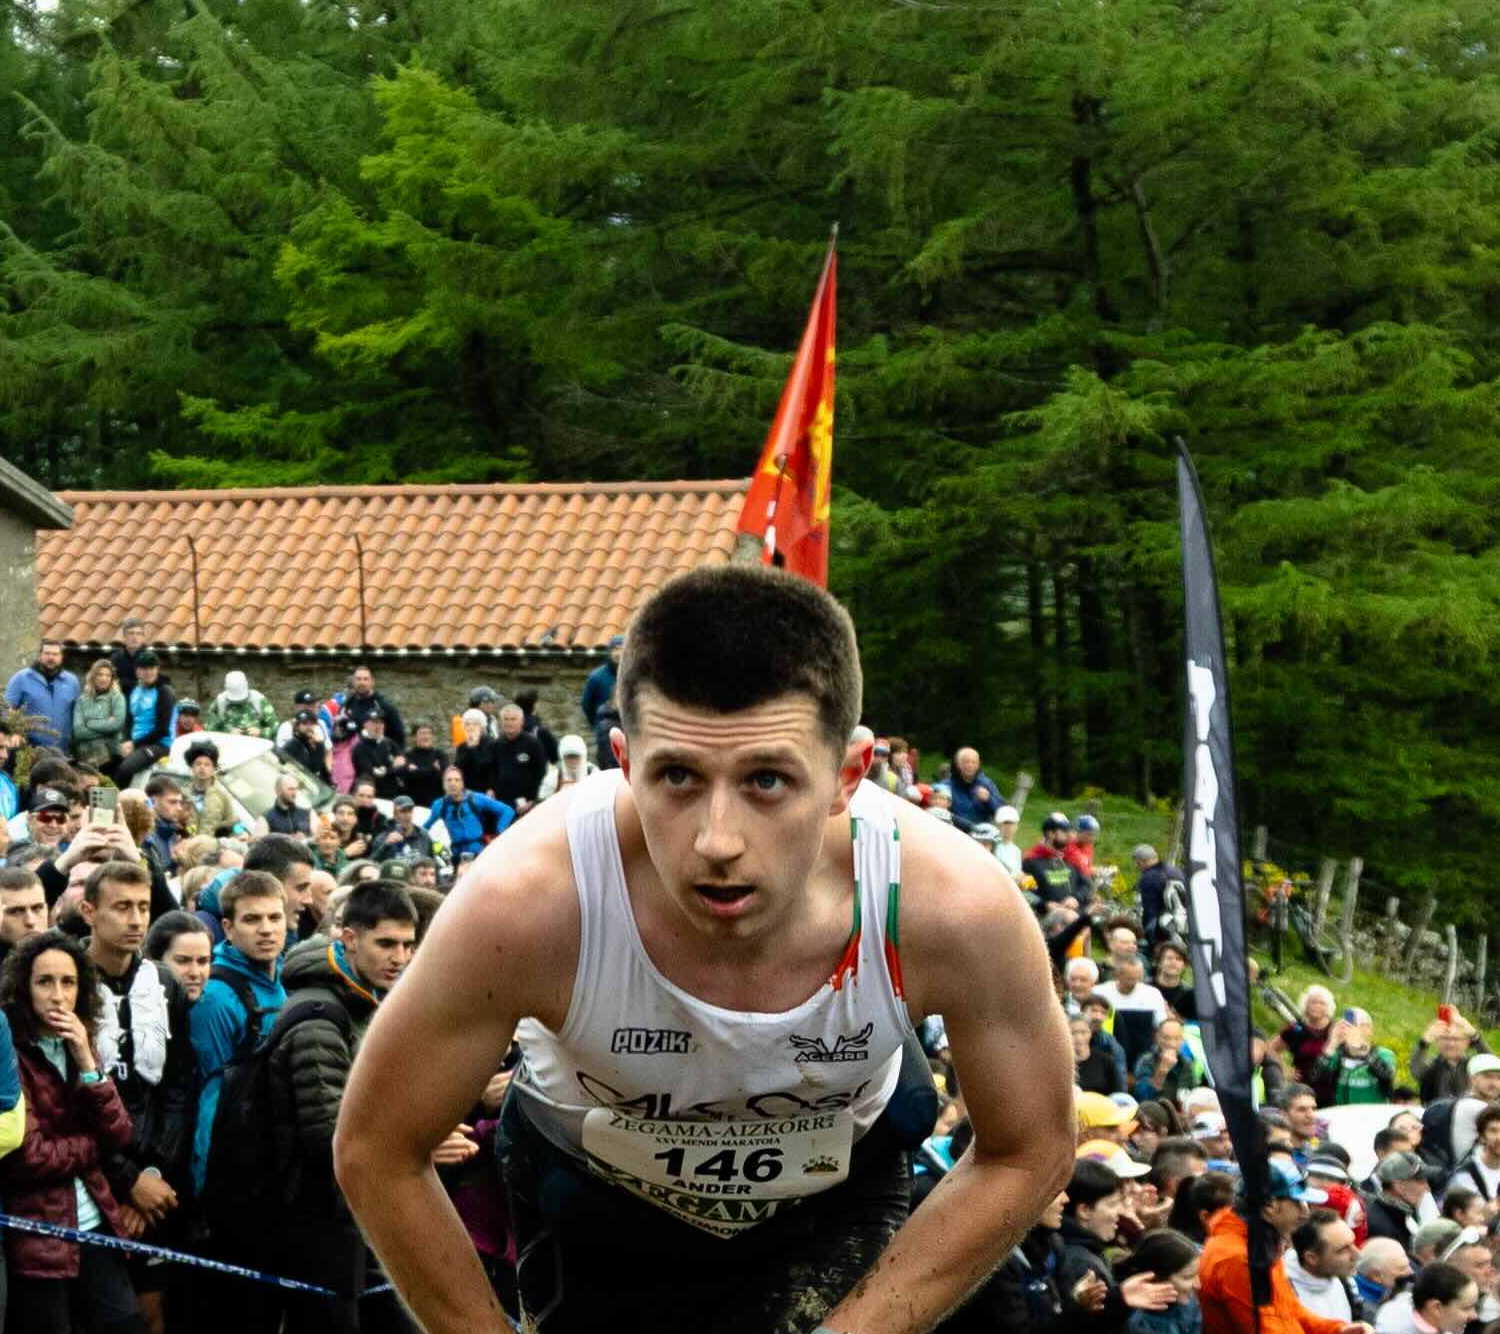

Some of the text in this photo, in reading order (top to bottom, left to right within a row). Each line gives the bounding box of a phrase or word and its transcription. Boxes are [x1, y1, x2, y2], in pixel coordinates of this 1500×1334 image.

[610, 1028, 692, 1055] POZIK
[681, 1137, 719, 1147] MENDI
[721, 1136, 782, 1147] MARATOIA
[654, 1147, 786, 1183] 146
[671, 1178, 753, 1195] ANDER
